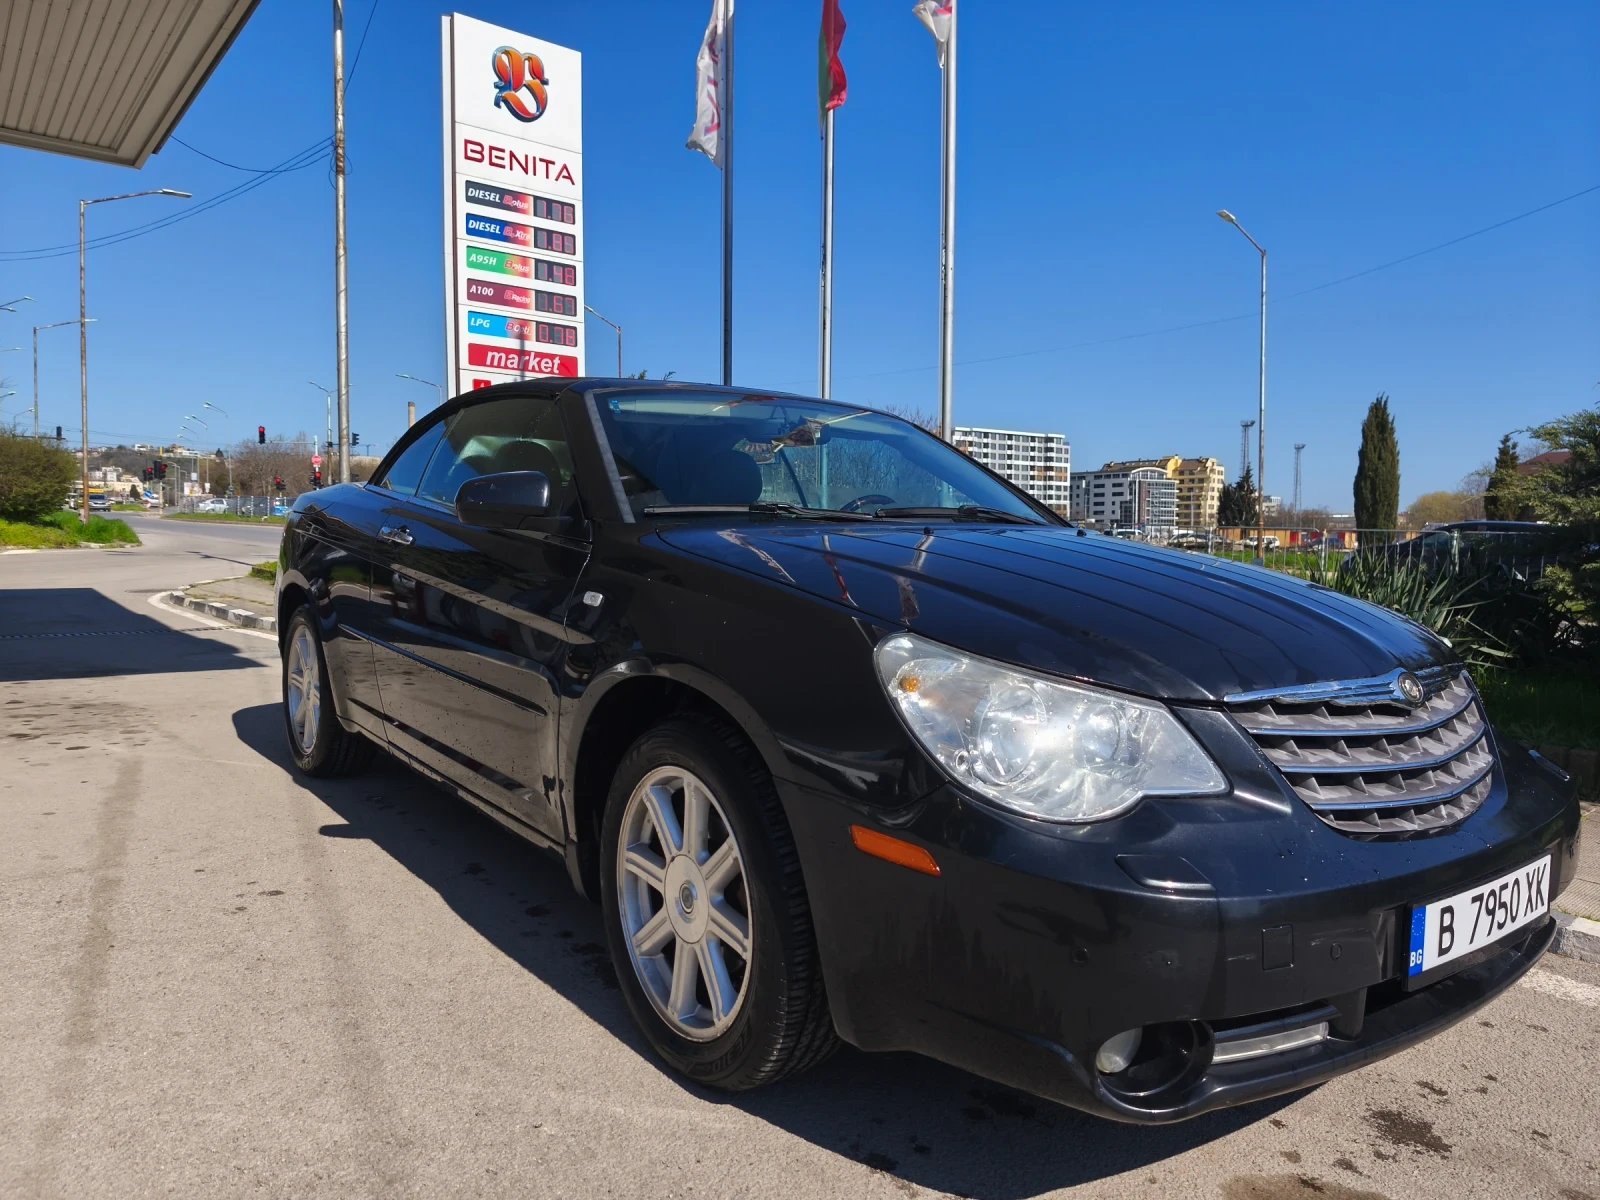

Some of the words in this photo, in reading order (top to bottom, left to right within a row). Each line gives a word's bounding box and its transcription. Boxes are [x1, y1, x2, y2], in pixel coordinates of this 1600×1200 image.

[464, 138, 576, 186] BENITA
[467, 187, 501, 203] DIESEL
[467, 219, 501, 235] DIESEL
[469, 252, 497, 266] A95H
[469, 284, 494, 297] A100
[470, 317, 490, 329] LPG
[485, 350, 561, 374] market
[1437, 904, 1455, 958] B
[1468, 877, 1521, 945] 7950
[1523, 863, 1547, 917] XK
[1409, 949, 1423, 967] BG
